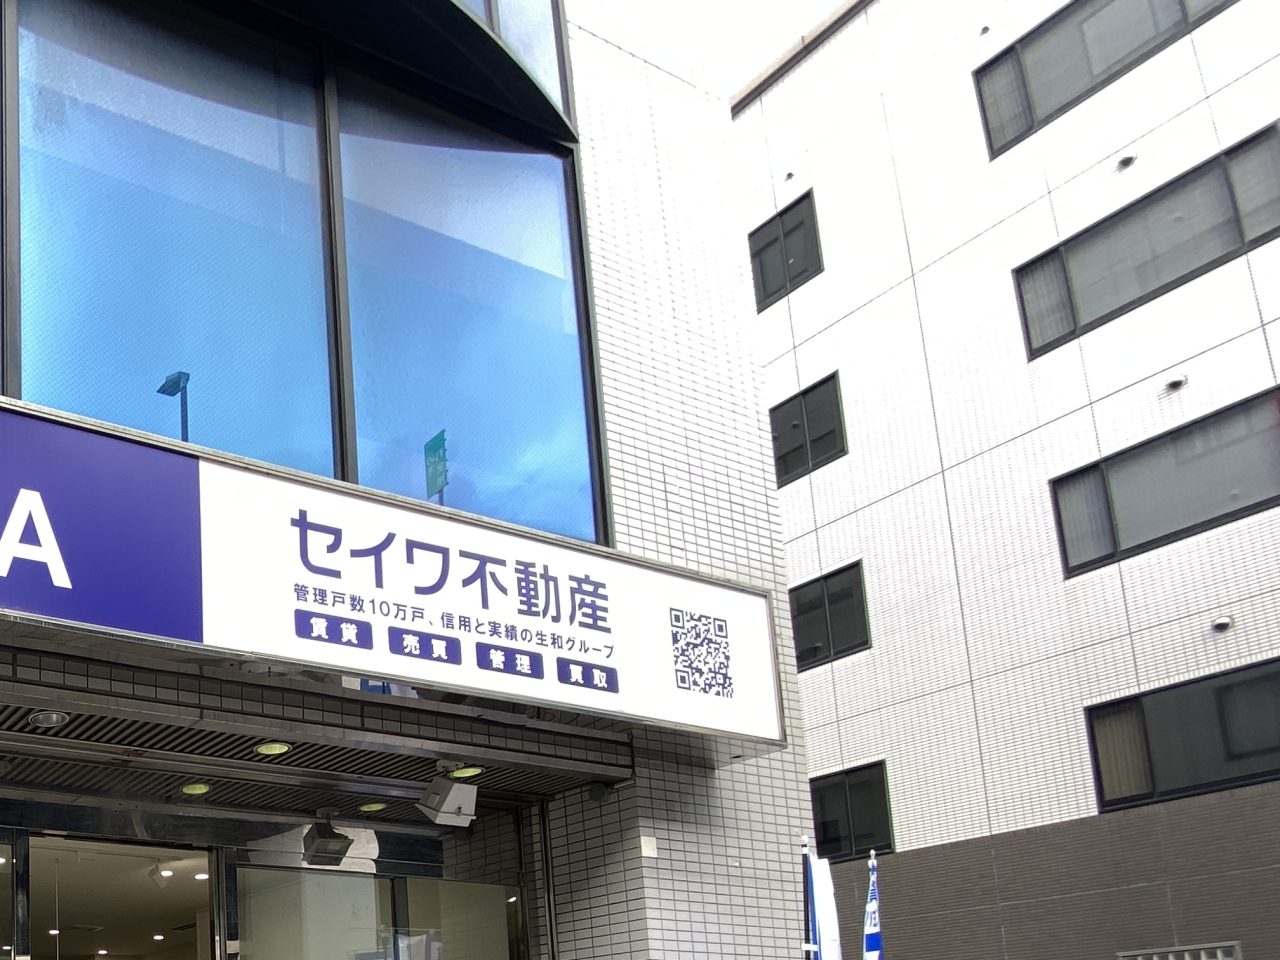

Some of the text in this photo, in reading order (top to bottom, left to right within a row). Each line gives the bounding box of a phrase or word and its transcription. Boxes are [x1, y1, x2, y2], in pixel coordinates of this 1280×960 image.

[290, 509, 612, 634] セイワ不動産
[294, 583, 614, 659] 管理戸数10万戸、信用と実績の生和グループ
[310, 616, 607, 688] 賃貸 売買 管理 買取
